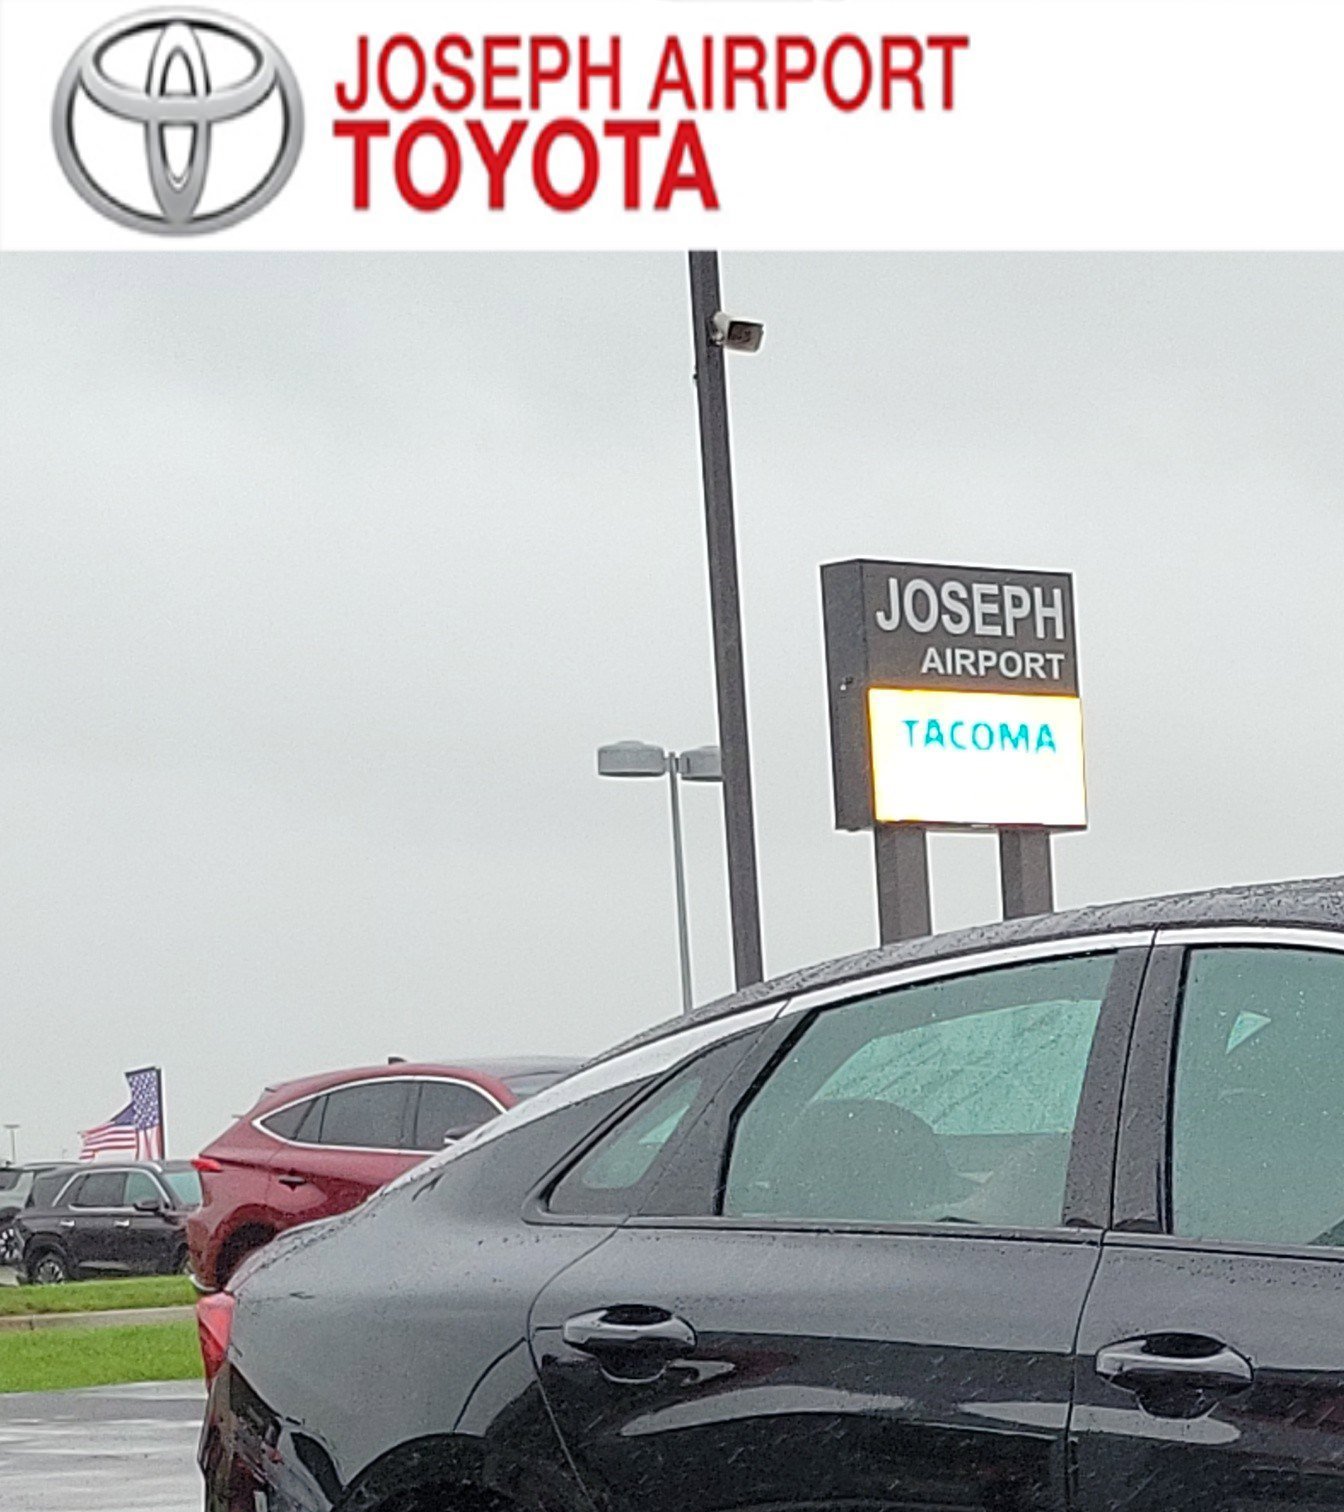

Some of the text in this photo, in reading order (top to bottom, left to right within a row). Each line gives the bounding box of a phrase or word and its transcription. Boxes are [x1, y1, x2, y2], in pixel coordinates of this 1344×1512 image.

[876, 577, 1065, 640] JOSEPH
[920, 647, 1065, 680] AIRPORT
[902, 718, 1057, 754] TACOMA
